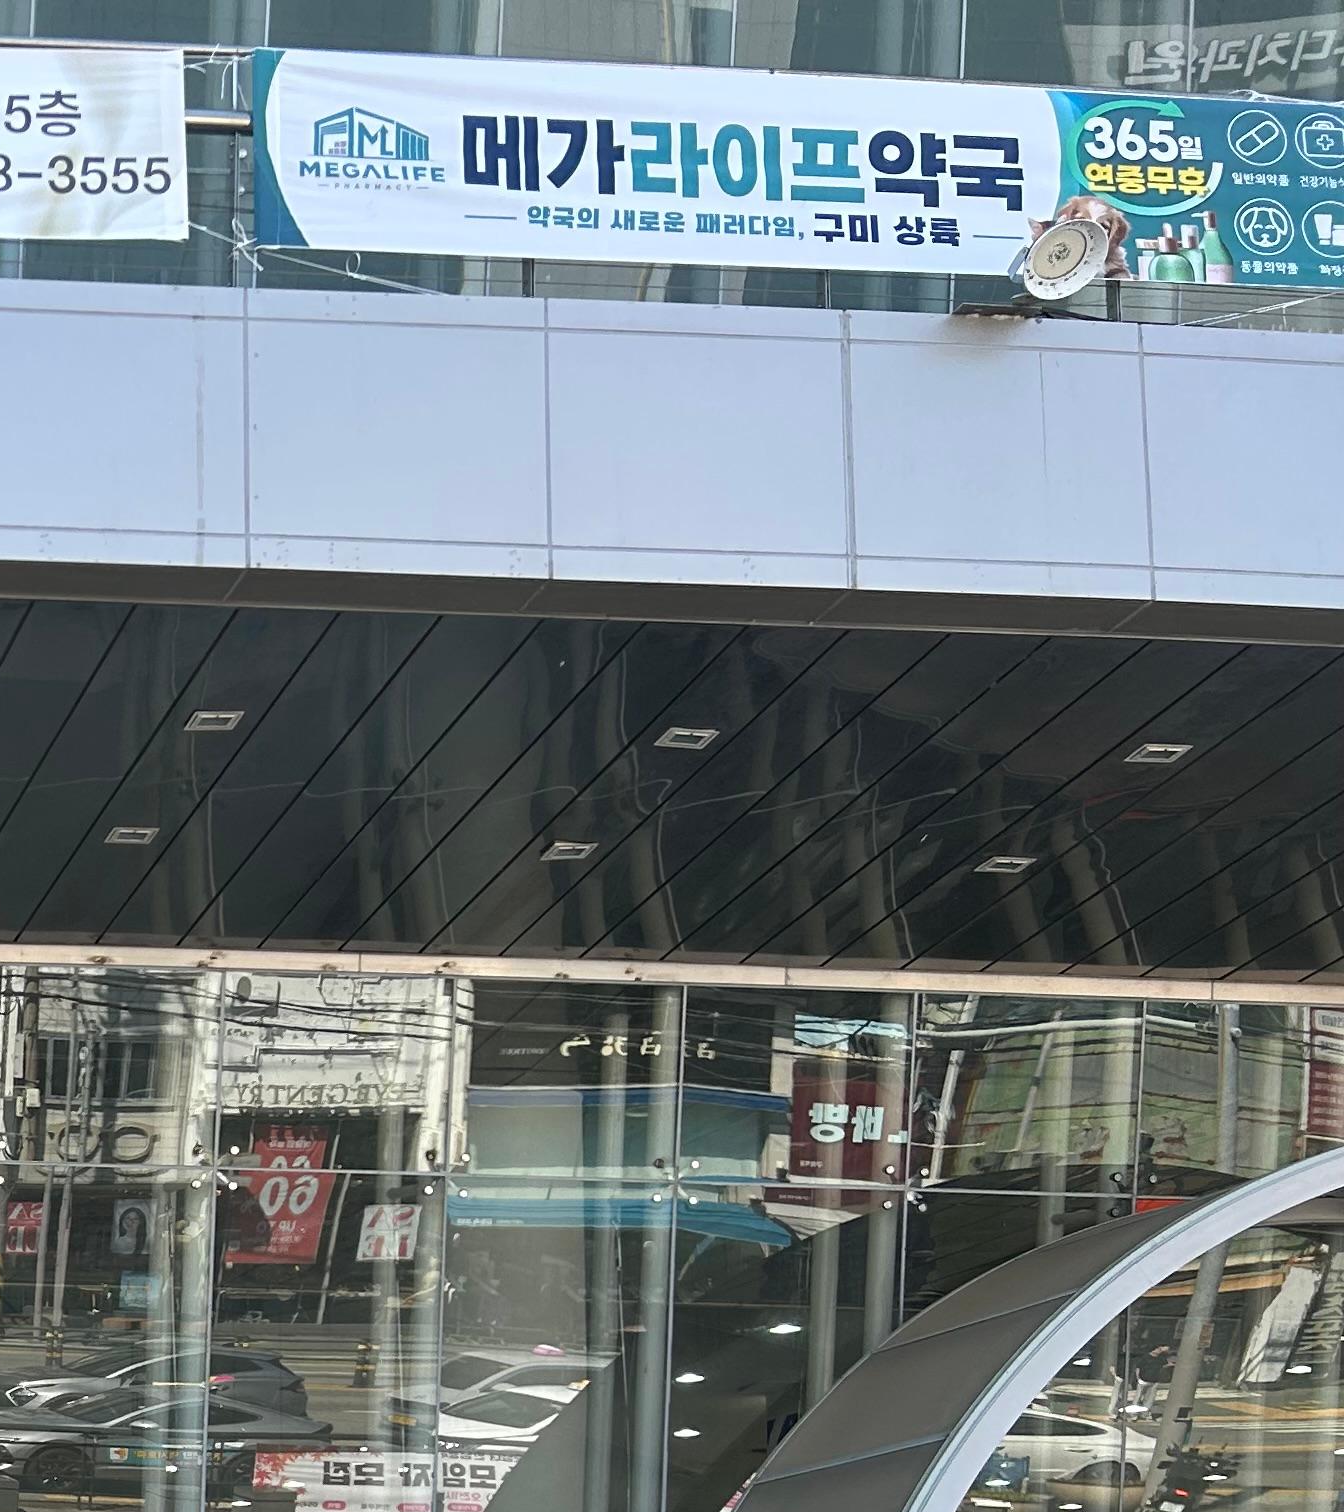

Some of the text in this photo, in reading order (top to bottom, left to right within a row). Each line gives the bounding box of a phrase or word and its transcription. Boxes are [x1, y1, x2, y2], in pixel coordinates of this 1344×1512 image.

[4, 90, 81, 136] 5층
[1084, 117, 1203, 162] 365일
[299, 160, 445, 183] MEGALIFE
[462, 115, 1023, 211] 메가라이프약국
[1084, 163, 1210, 198] 연중무휴
[1232, 172, 1289, 187] 일반의약품
[334, 183, 412, 191] PHARMACY
[528, 206, 960, 246] 약국의 새로운 패러다임, 구미 상륙
[1319, 264, 1344, 277] 화장
